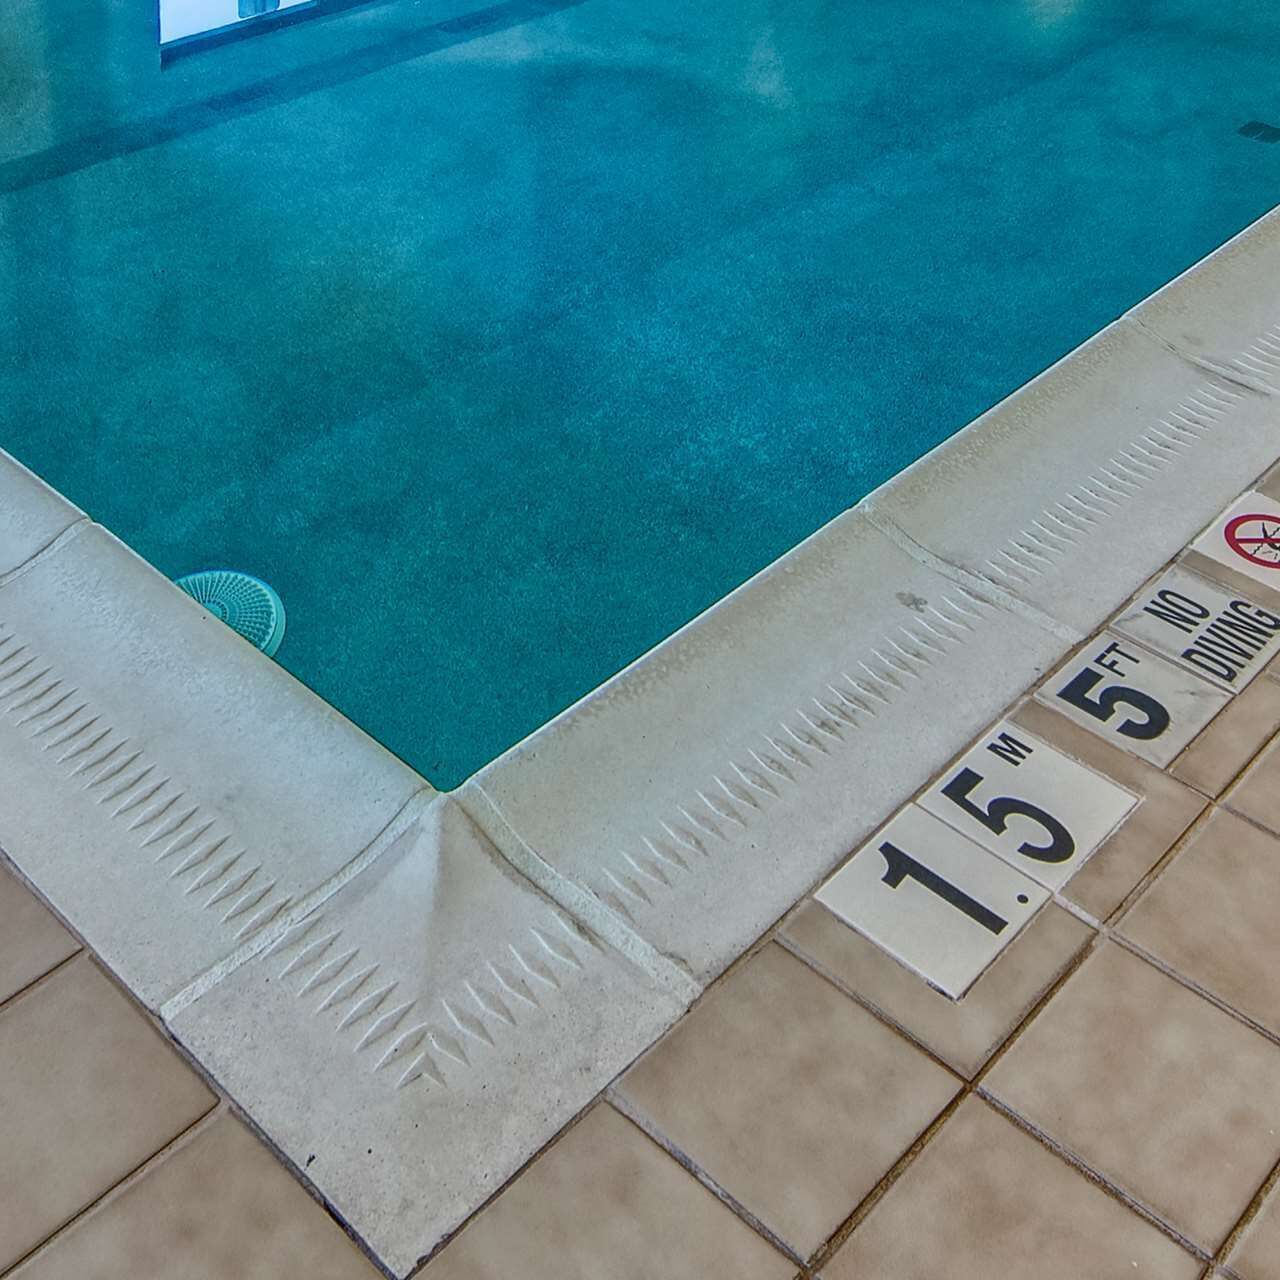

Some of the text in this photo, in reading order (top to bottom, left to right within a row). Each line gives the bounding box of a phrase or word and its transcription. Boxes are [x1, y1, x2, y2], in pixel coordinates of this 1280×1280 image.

[1143, 589, 1210, 634] NO
[1056, 641, 1170, 740] 5 FT
[986, 732, 1034, 767] M
